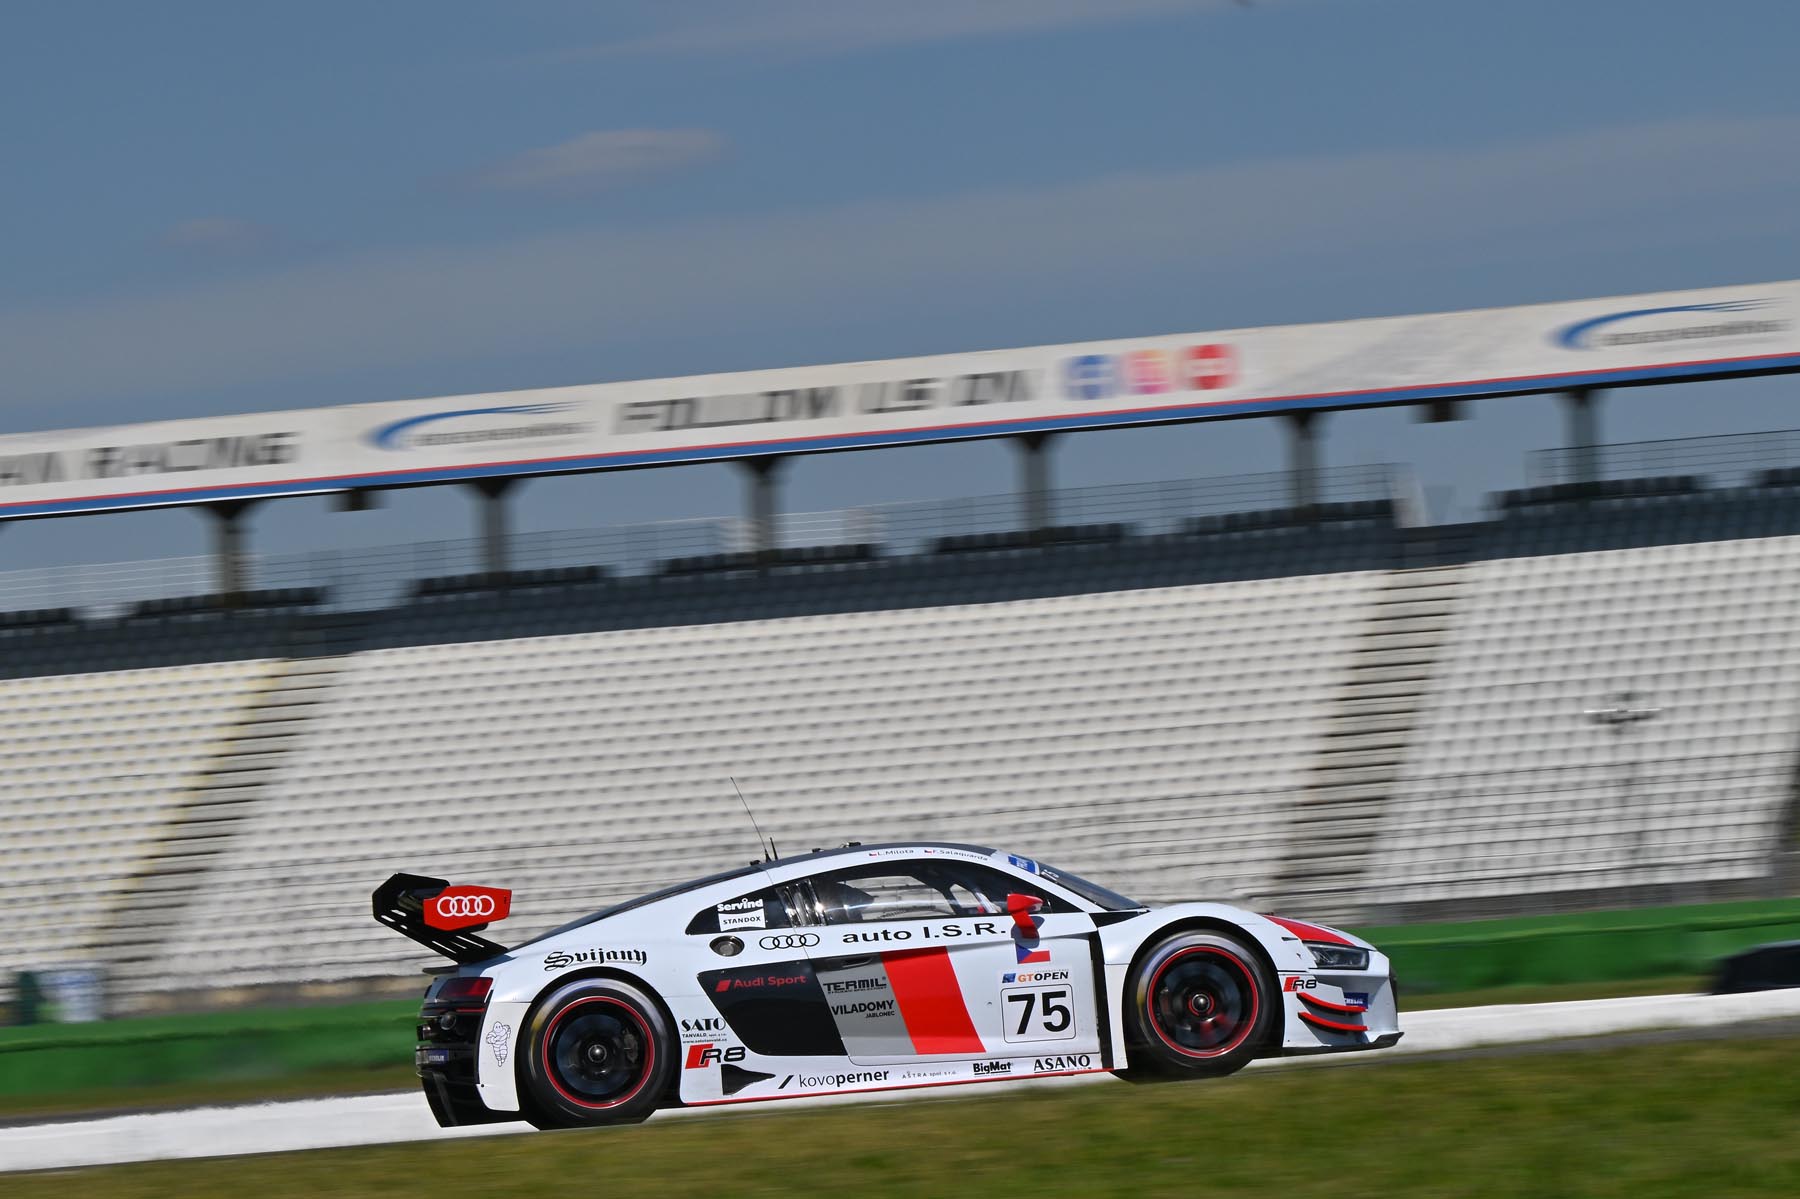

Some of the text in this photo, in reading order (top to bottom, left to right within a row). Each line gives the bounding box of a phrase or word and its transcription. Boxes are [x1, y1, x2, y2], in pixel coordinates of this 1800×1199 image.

[717, 898, 763, 912] Servind
[723, 916, 761, 925] STANDOX
[842, 922, 1006, 944] auto I.S.R.
[544, 948, 647, 971] Svijany
[733, 975, 806, 989] Audi Sport
[823, 978, 887, 992] TERMIL
[831, 1000, 894, 1016] VILADOMY
[1007, 990, 1071, 1035] 75
[681, 1018, 726, 1032] SATO
[700, 1046, 746, 1065] R8
[1034, 1055, 1091, 1071] ASANO
[973, 1062, 1012, 1074] BigMat
[799, 1070, 889, 1088] kovoperner
